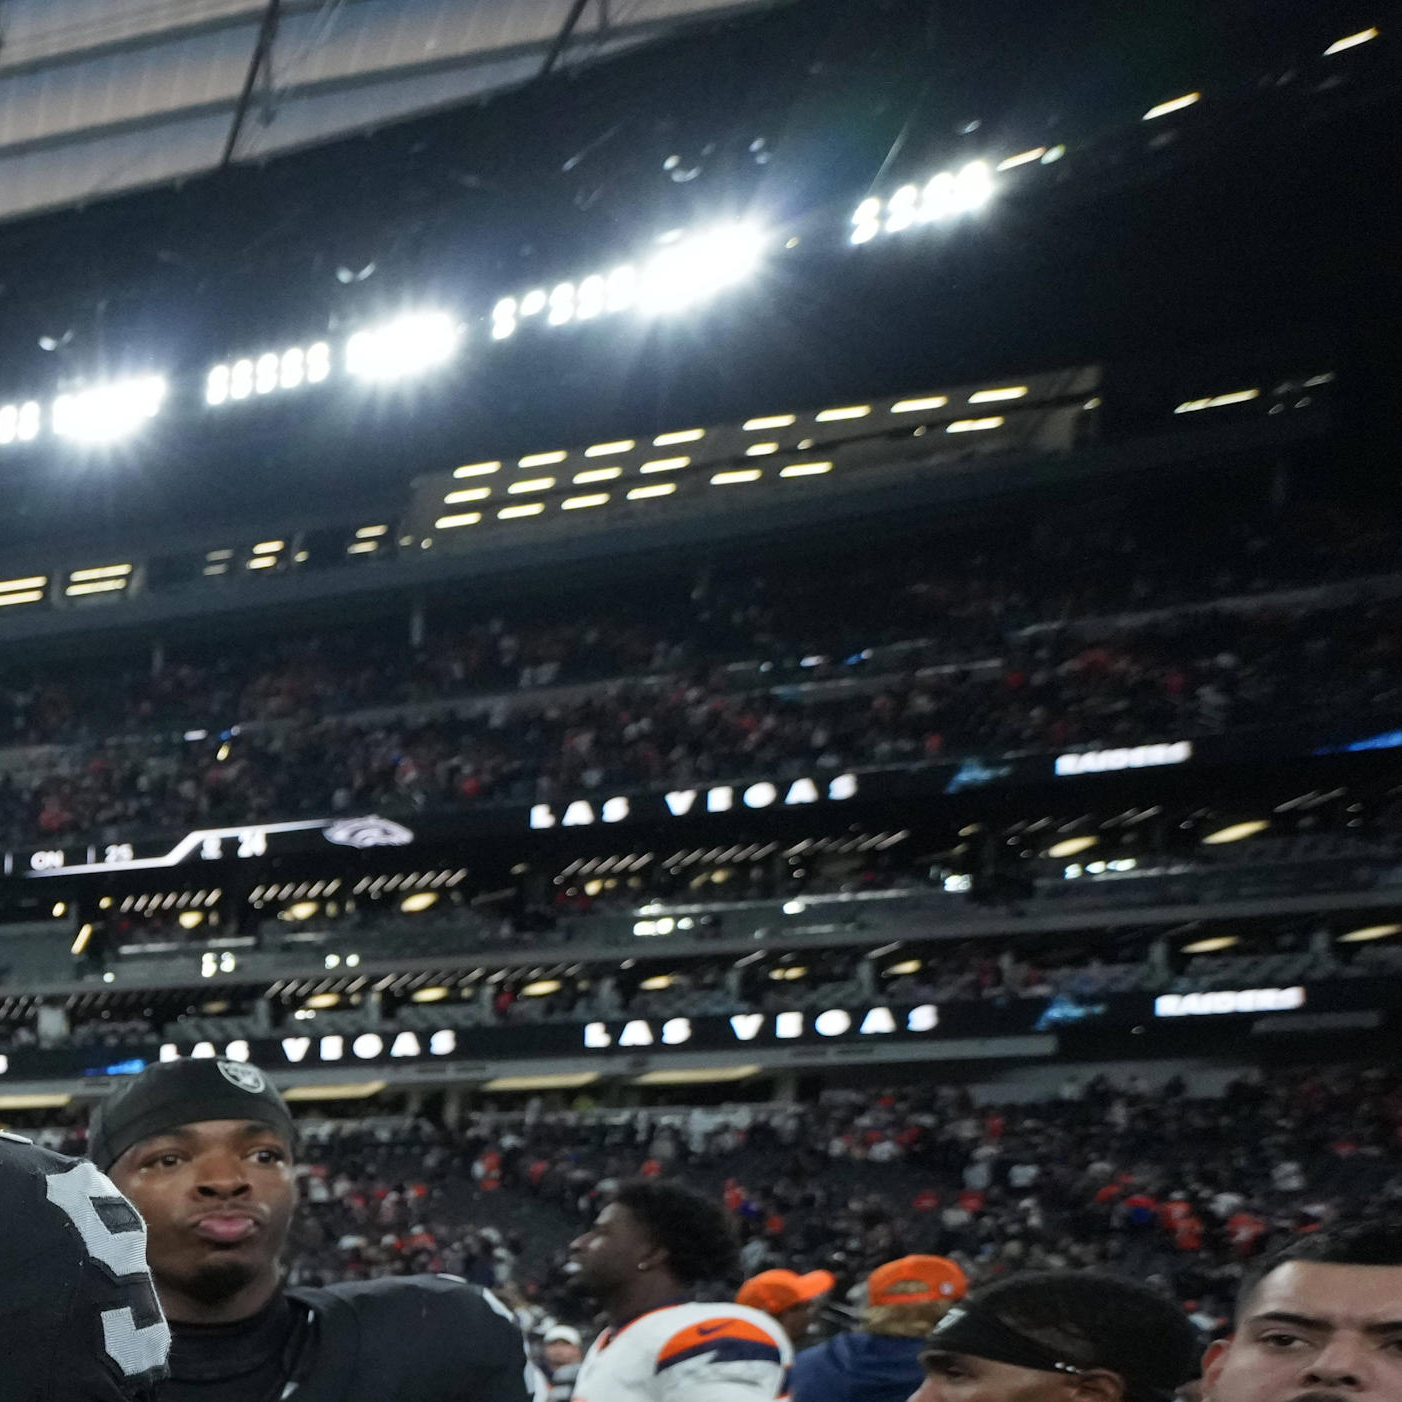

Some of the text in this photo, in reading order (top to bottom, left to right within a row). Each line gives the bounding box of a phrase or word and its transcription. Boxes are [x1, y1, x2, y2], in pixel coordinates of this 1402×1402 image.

[530, 773, 858, 829] LAS VEGAS
[281, 1029, 457, 1063] VEGAS
[584, 1004, 939, 1048] LAS VEGAS
